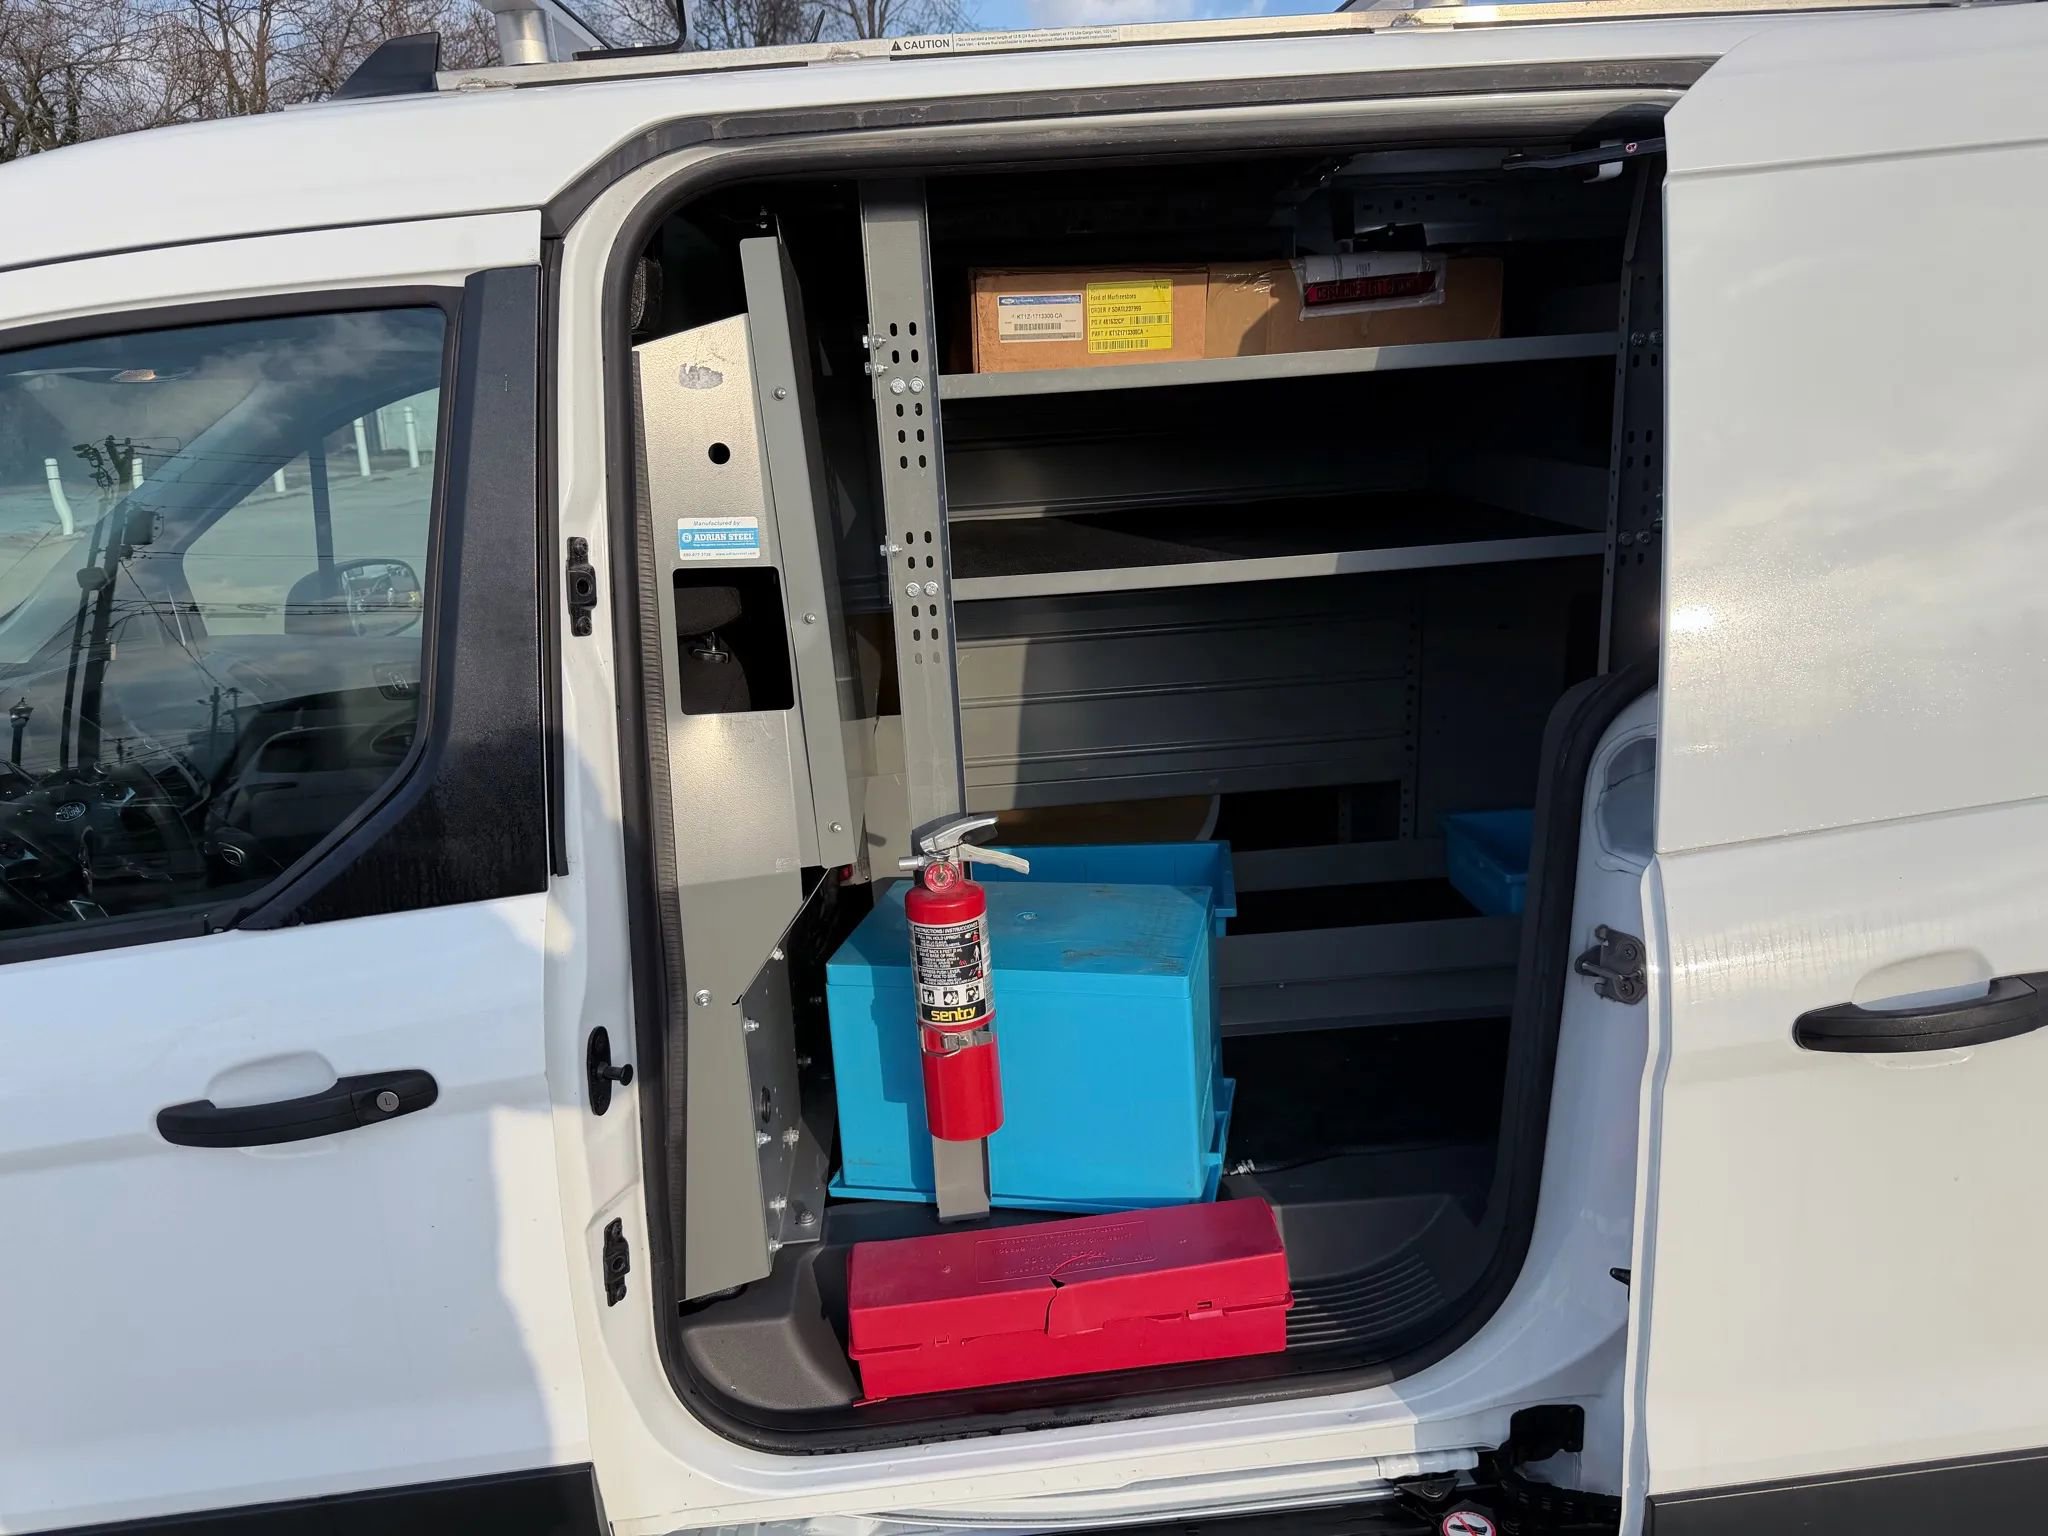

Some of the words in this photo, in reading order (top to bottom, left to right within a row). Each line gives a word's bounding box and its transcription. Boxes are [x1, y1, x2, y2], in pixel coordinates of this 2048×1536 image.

[903, 39, 950, 50] CAUTION
[1090, 293, 1101, 301] Ford
[694, 533, 727, 541] ADRIAN
[728, 532, 754, 540] STEEL
[931, 1007, 976, 1021] sentry
